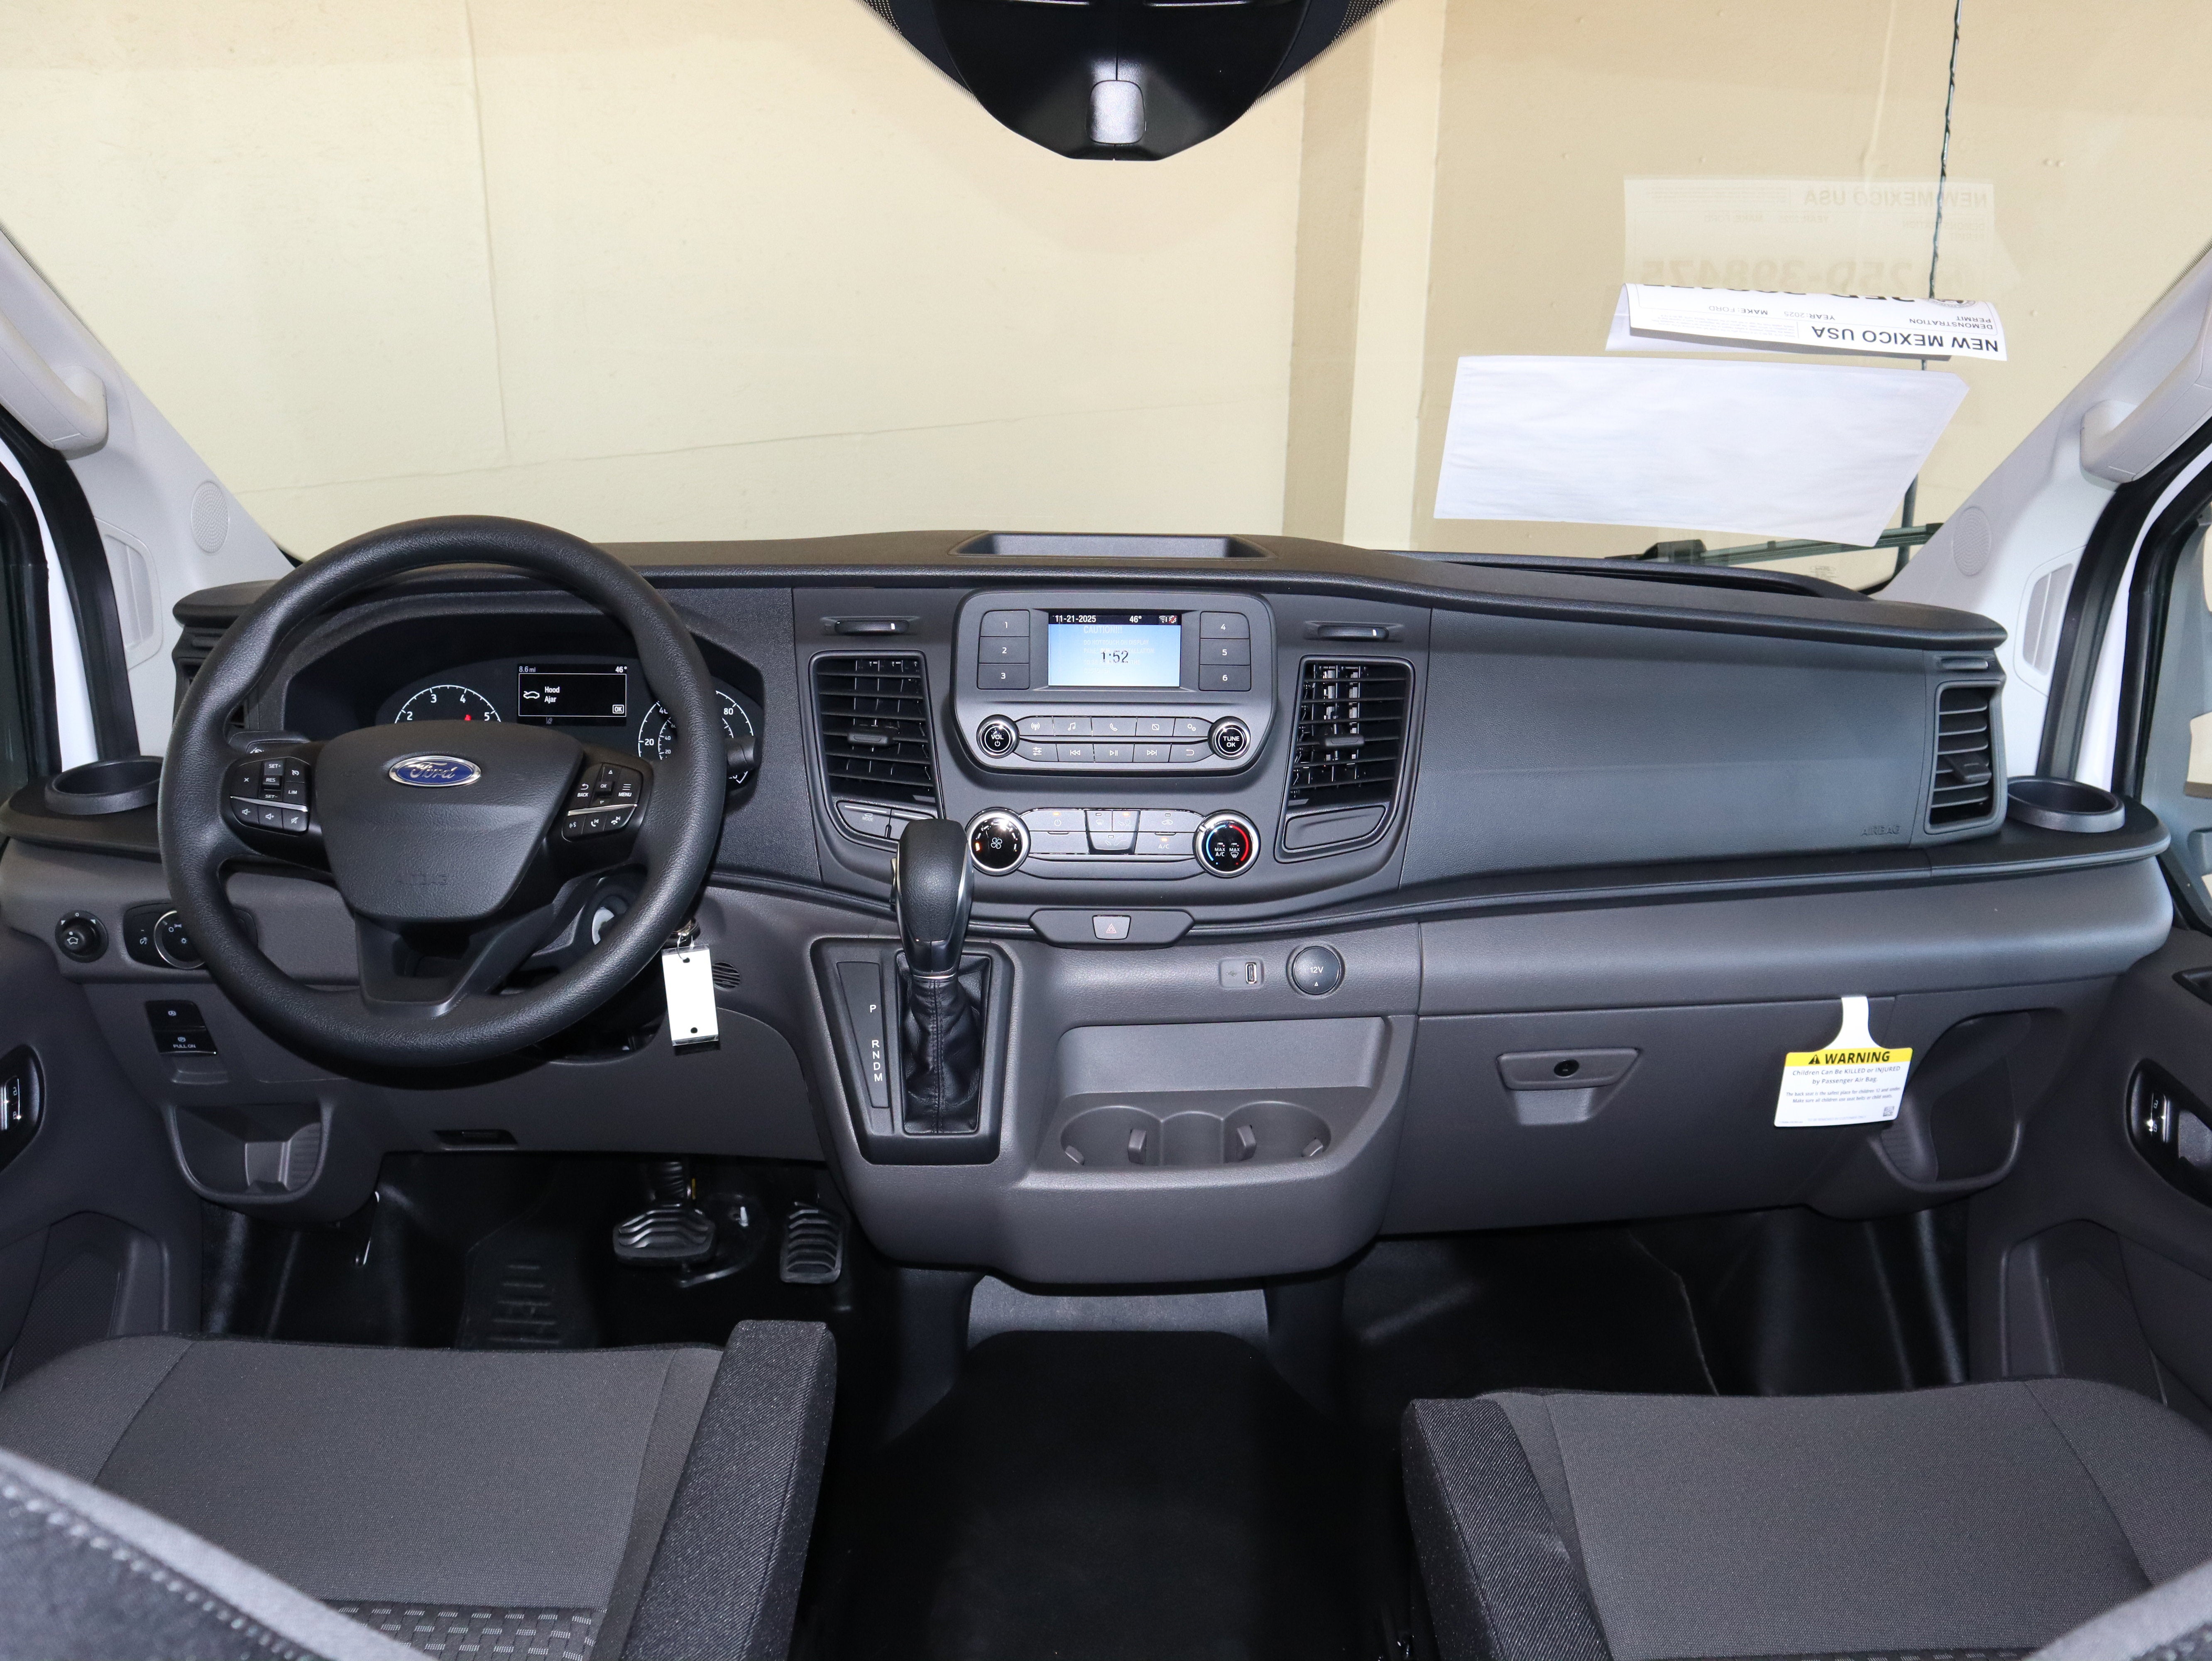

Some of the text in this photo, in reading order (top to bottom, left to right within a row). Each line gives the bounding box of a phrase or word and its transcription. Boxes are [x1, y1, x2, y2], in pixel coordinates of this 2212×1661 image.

[1909, 318, 1993, 329] DEMONSTRATION
[1811, 326, 1855, 341] USA
[1862, 331, 1944, 347] MEXICO
[1951, 337, 1998, 352] NEW
[1101, 650, 1129, 663] 1:52
[431, 694, 437, 703] 3
[460, 694, 466, 703] 4
[407, 711, 413, 720] 2
[484, 712, 490, 721] 5
[405, 762, 458, 779] Ford
[1825, 1051, 1890, 1064] WARNING
[874, 1073, 882, 1081] M
